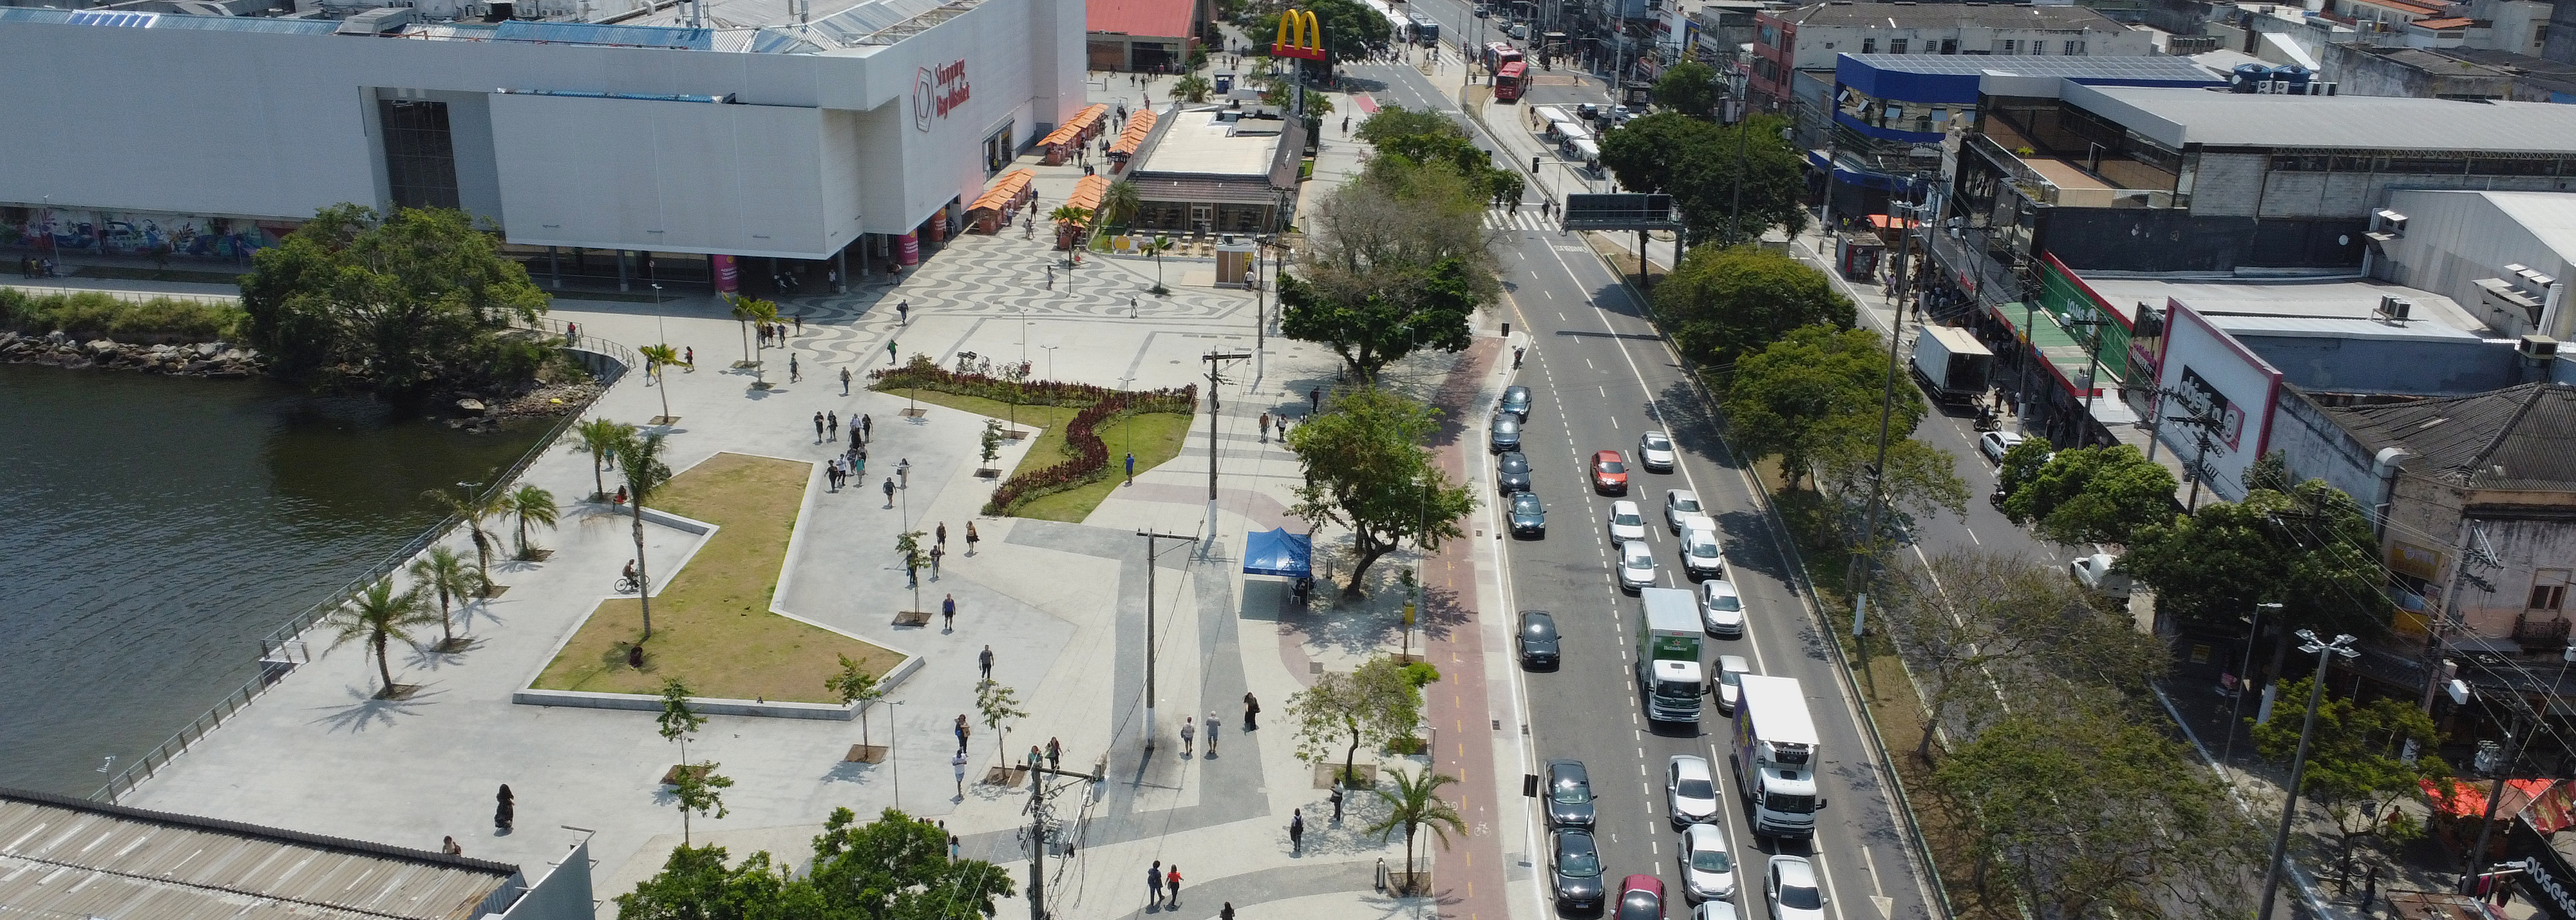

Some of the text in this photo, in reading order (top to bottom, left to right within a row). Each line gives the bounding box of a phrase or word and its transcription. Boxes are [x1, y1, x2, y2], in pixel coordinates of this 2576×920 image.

[935, 58, 965, 88] Shopping
[949, 81, 971, 110] Market
[2066, 298, 2085, 321] LOJAS
